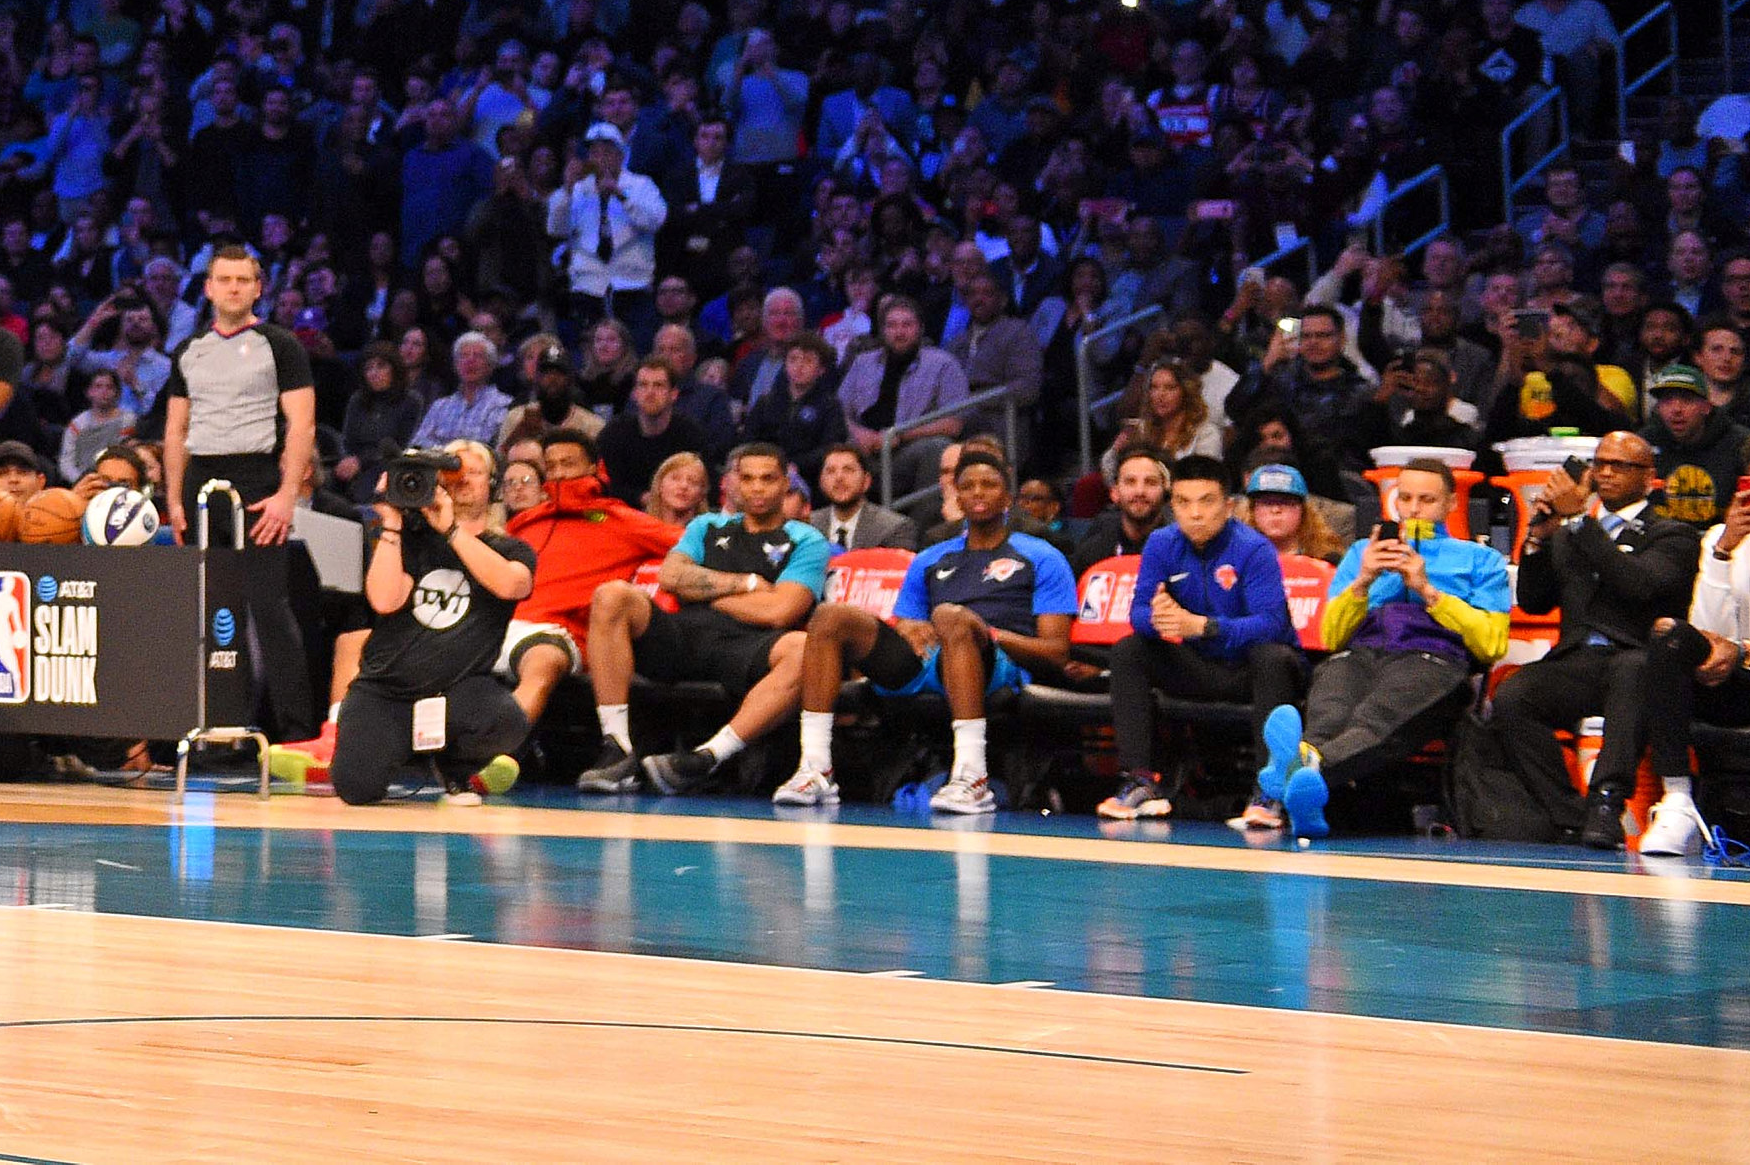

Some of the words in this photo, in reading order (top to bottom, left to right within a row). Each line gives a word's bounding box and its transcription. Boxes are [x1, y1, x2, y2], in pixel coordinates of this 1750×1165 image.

[58, 580, 98, 599] AT&T
[33, 604, 98, 655] SLAM
[33, 655, 98, 704] DUNK
